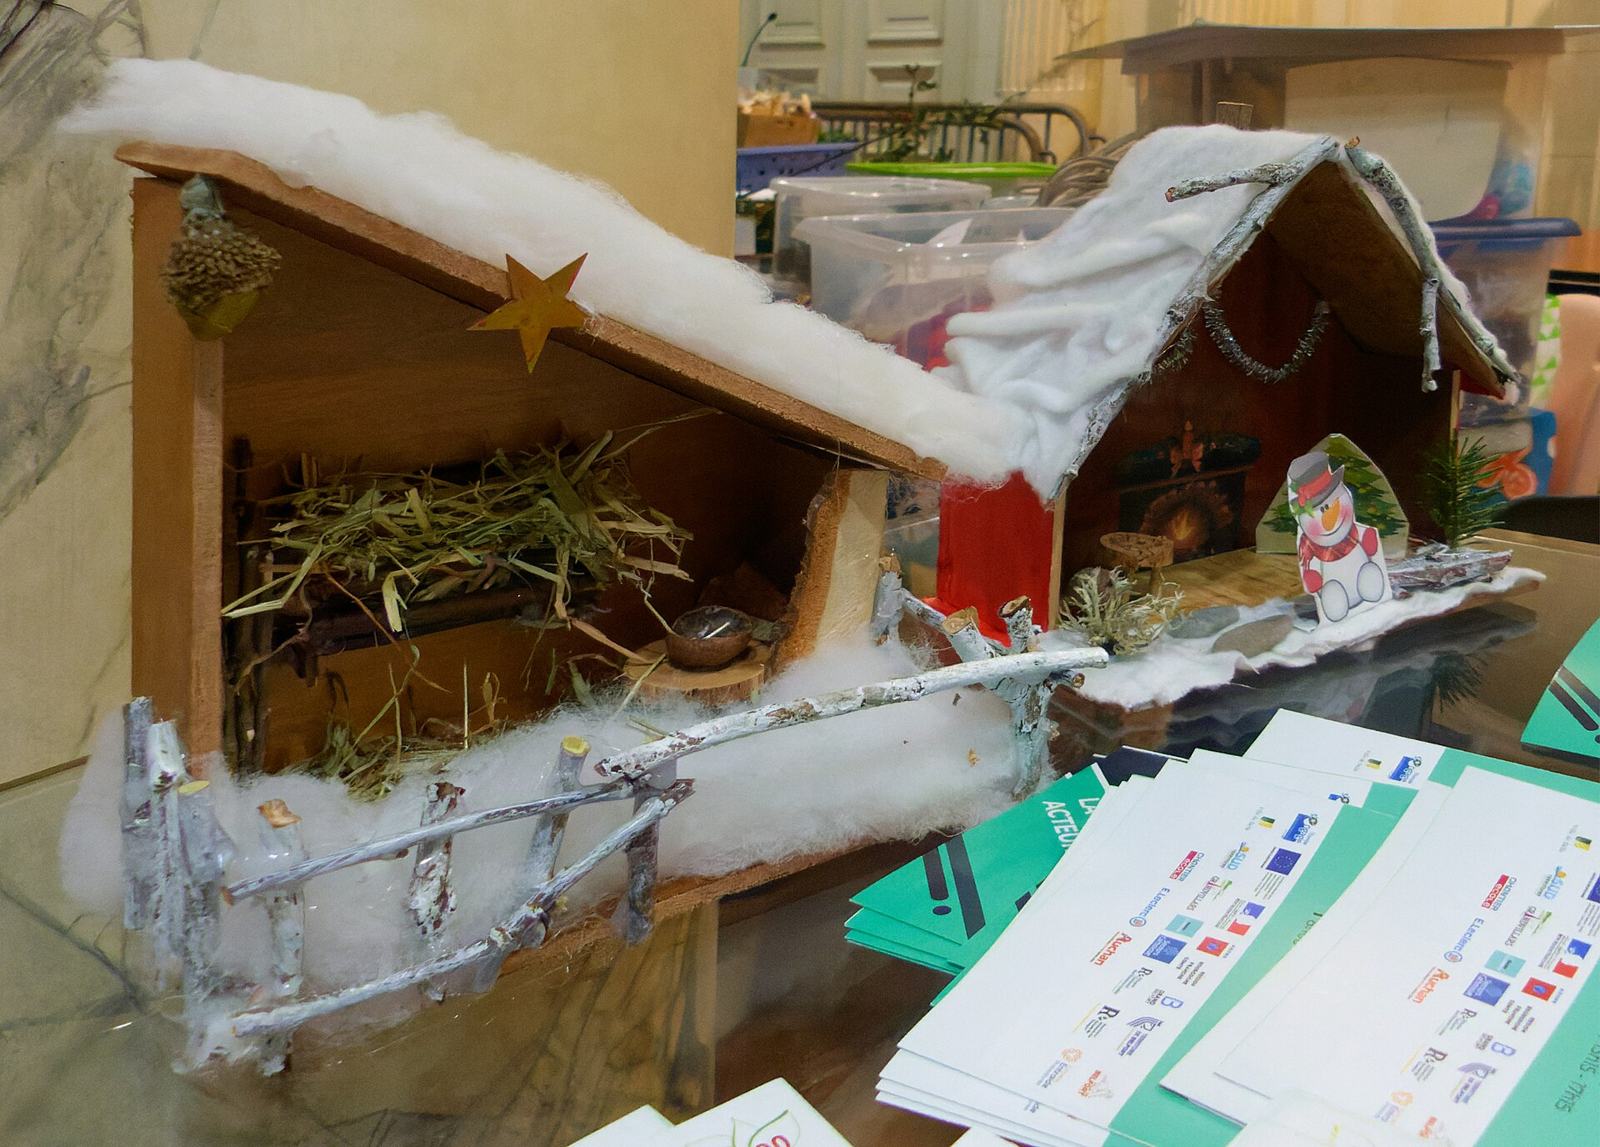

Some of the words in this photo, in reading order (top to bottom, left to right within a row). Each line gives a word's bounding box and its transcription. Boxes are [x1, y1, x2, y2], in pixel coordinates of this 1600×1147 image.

[1227, 852, 1246, 870] SUD
[1094, 933, 1132, 966] Auchan
[1454, 917, 1485, 951] E.Leclerc
[1412, 968, 1450, 1004] Auchan
